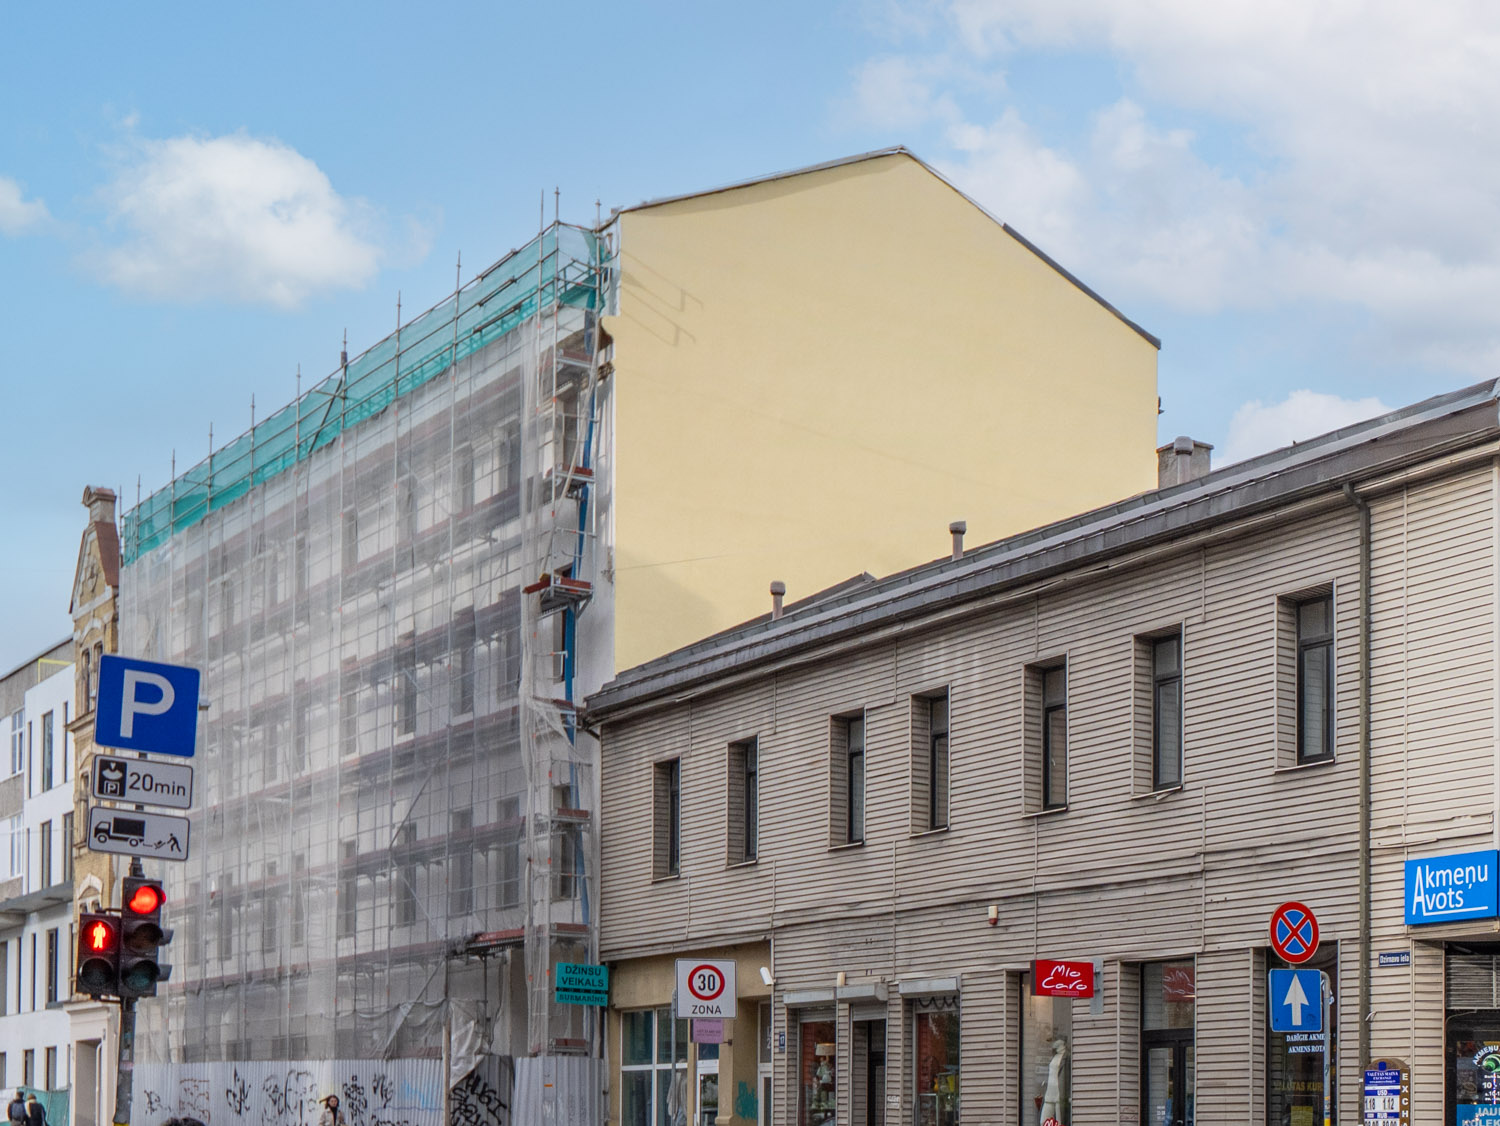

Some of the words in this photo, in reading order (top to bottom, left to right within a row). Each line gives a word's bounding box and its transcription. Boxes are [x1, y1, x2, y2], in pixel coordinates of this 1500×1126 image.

[120, 669, 175, 739] P
[129, 772, 185, 797] 20min
[1413, 864, 1488, 895] Akmeņu
[1401, 954, 1410, 963] iela
[565, 965, 602, 977] DŽINSU
[1051, 965, 1081, 978] Mio
[562, 977, 604, 987] VEIKALS
[698, 974, 716, 991] 30
[1042, 976, 1088, 991] Caro
[692, 1005, 722, 1014] ZONA
[1288, 1045, 1310, 1053] AKMENS
[1473, 1045, 1498, 1065] AKMEŅU
